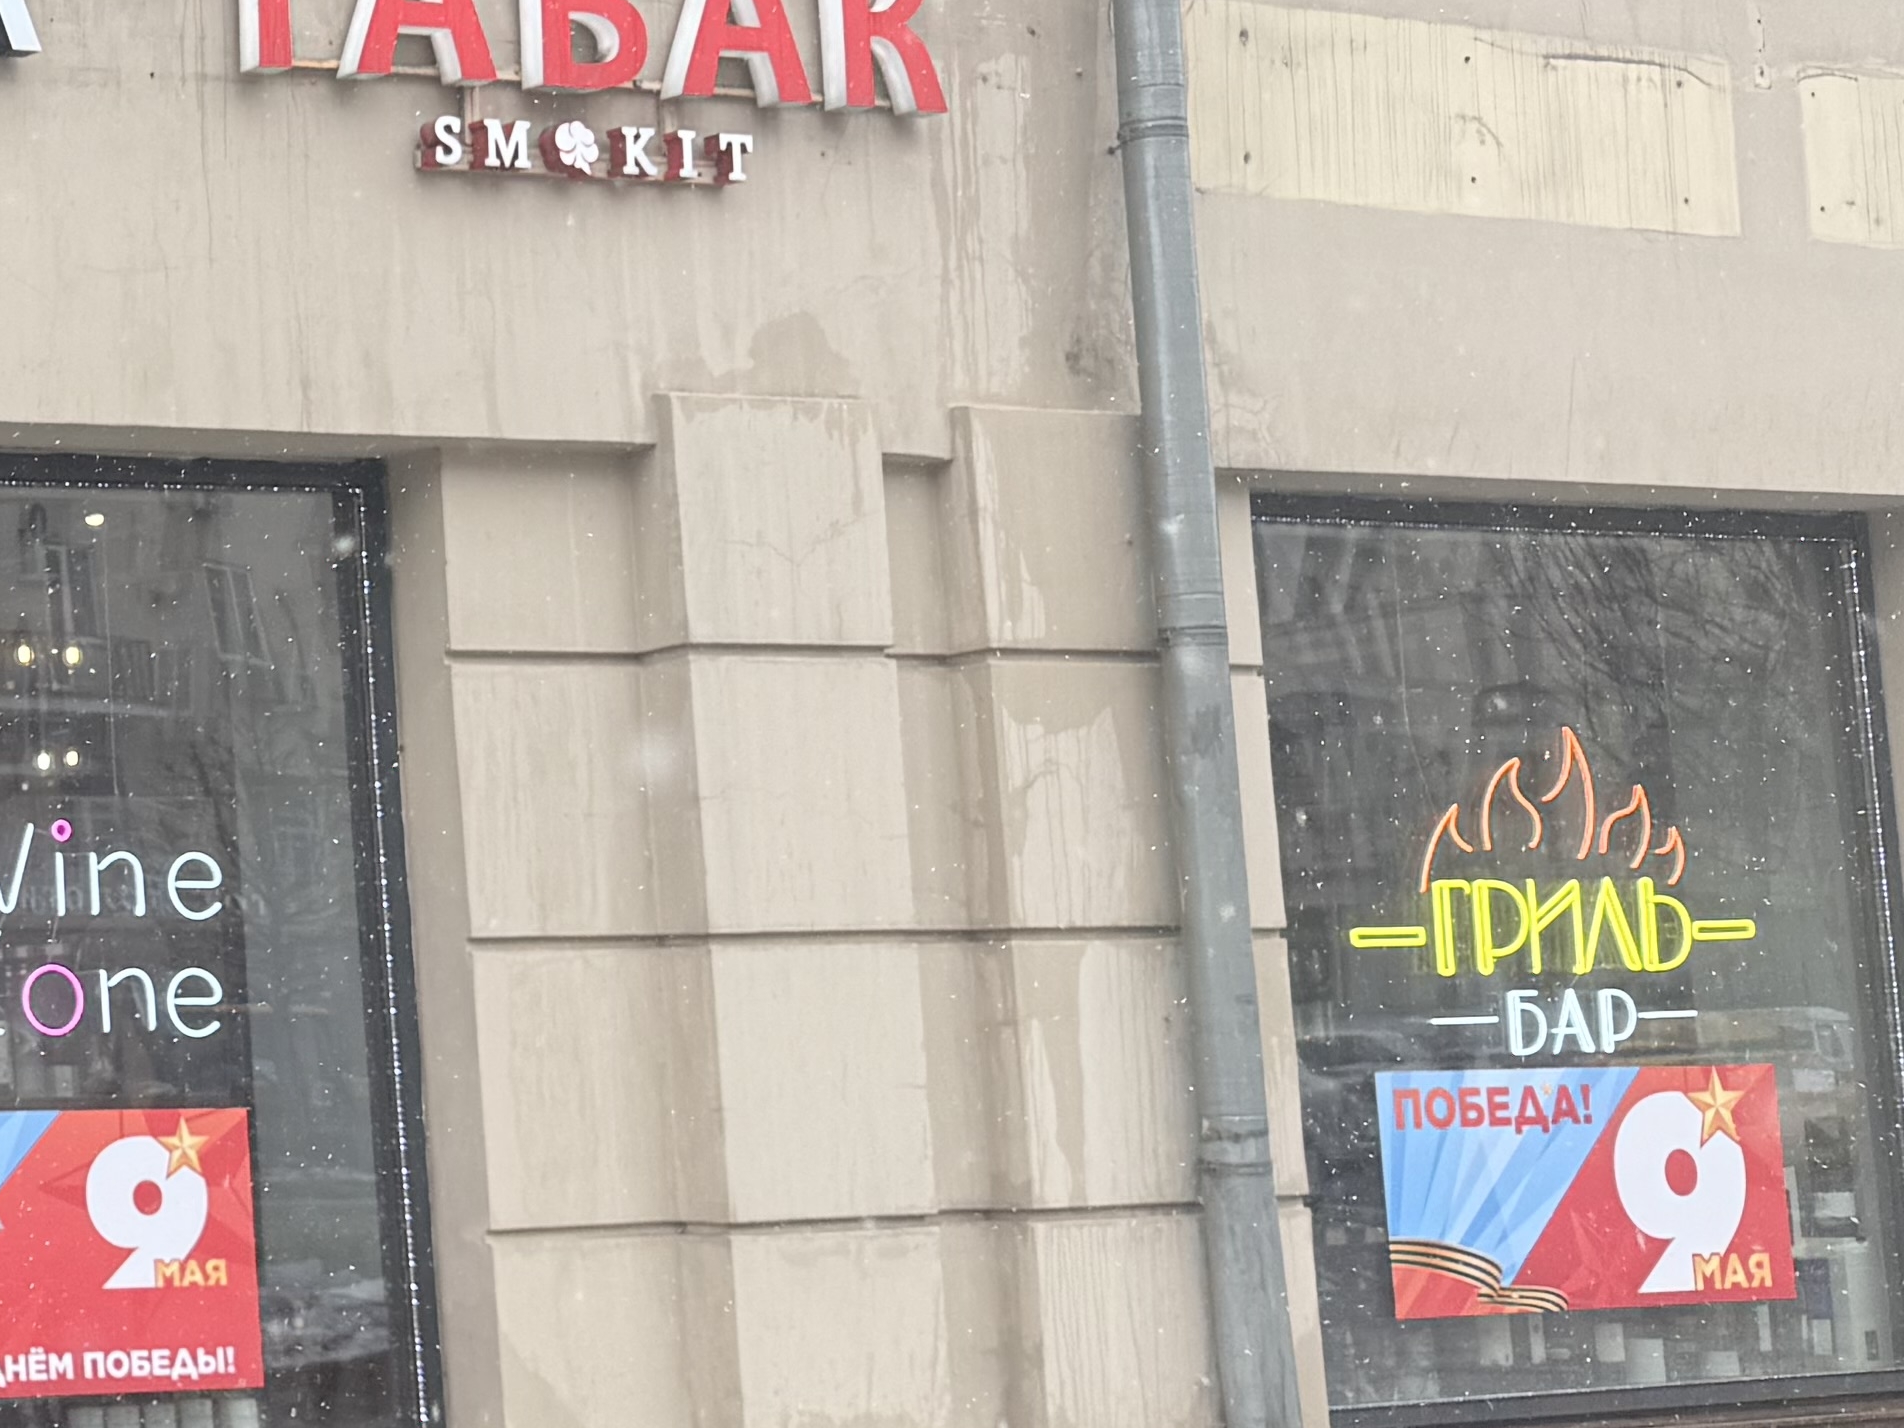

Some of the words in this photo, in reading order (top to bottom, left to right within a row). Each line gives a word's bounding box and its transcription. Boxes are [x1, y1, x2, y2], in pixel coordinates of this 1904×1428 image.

[1431, 876, 1693, 977] ГРИЛЬ
[1505, 988, 1638, 1057] БАР
[1392, 1083, 1593, 1135] ПОБЕДА!
[85, 1134, 209, 1290] 9
[1614, 1090, 1747, 1294] 9
[153, 1258, 228, 1289] МАЯ
[1693, 1252, 1773, 1291] МАЯ
[82, 1345, 236, 1381] ПОБЕДЫ!
